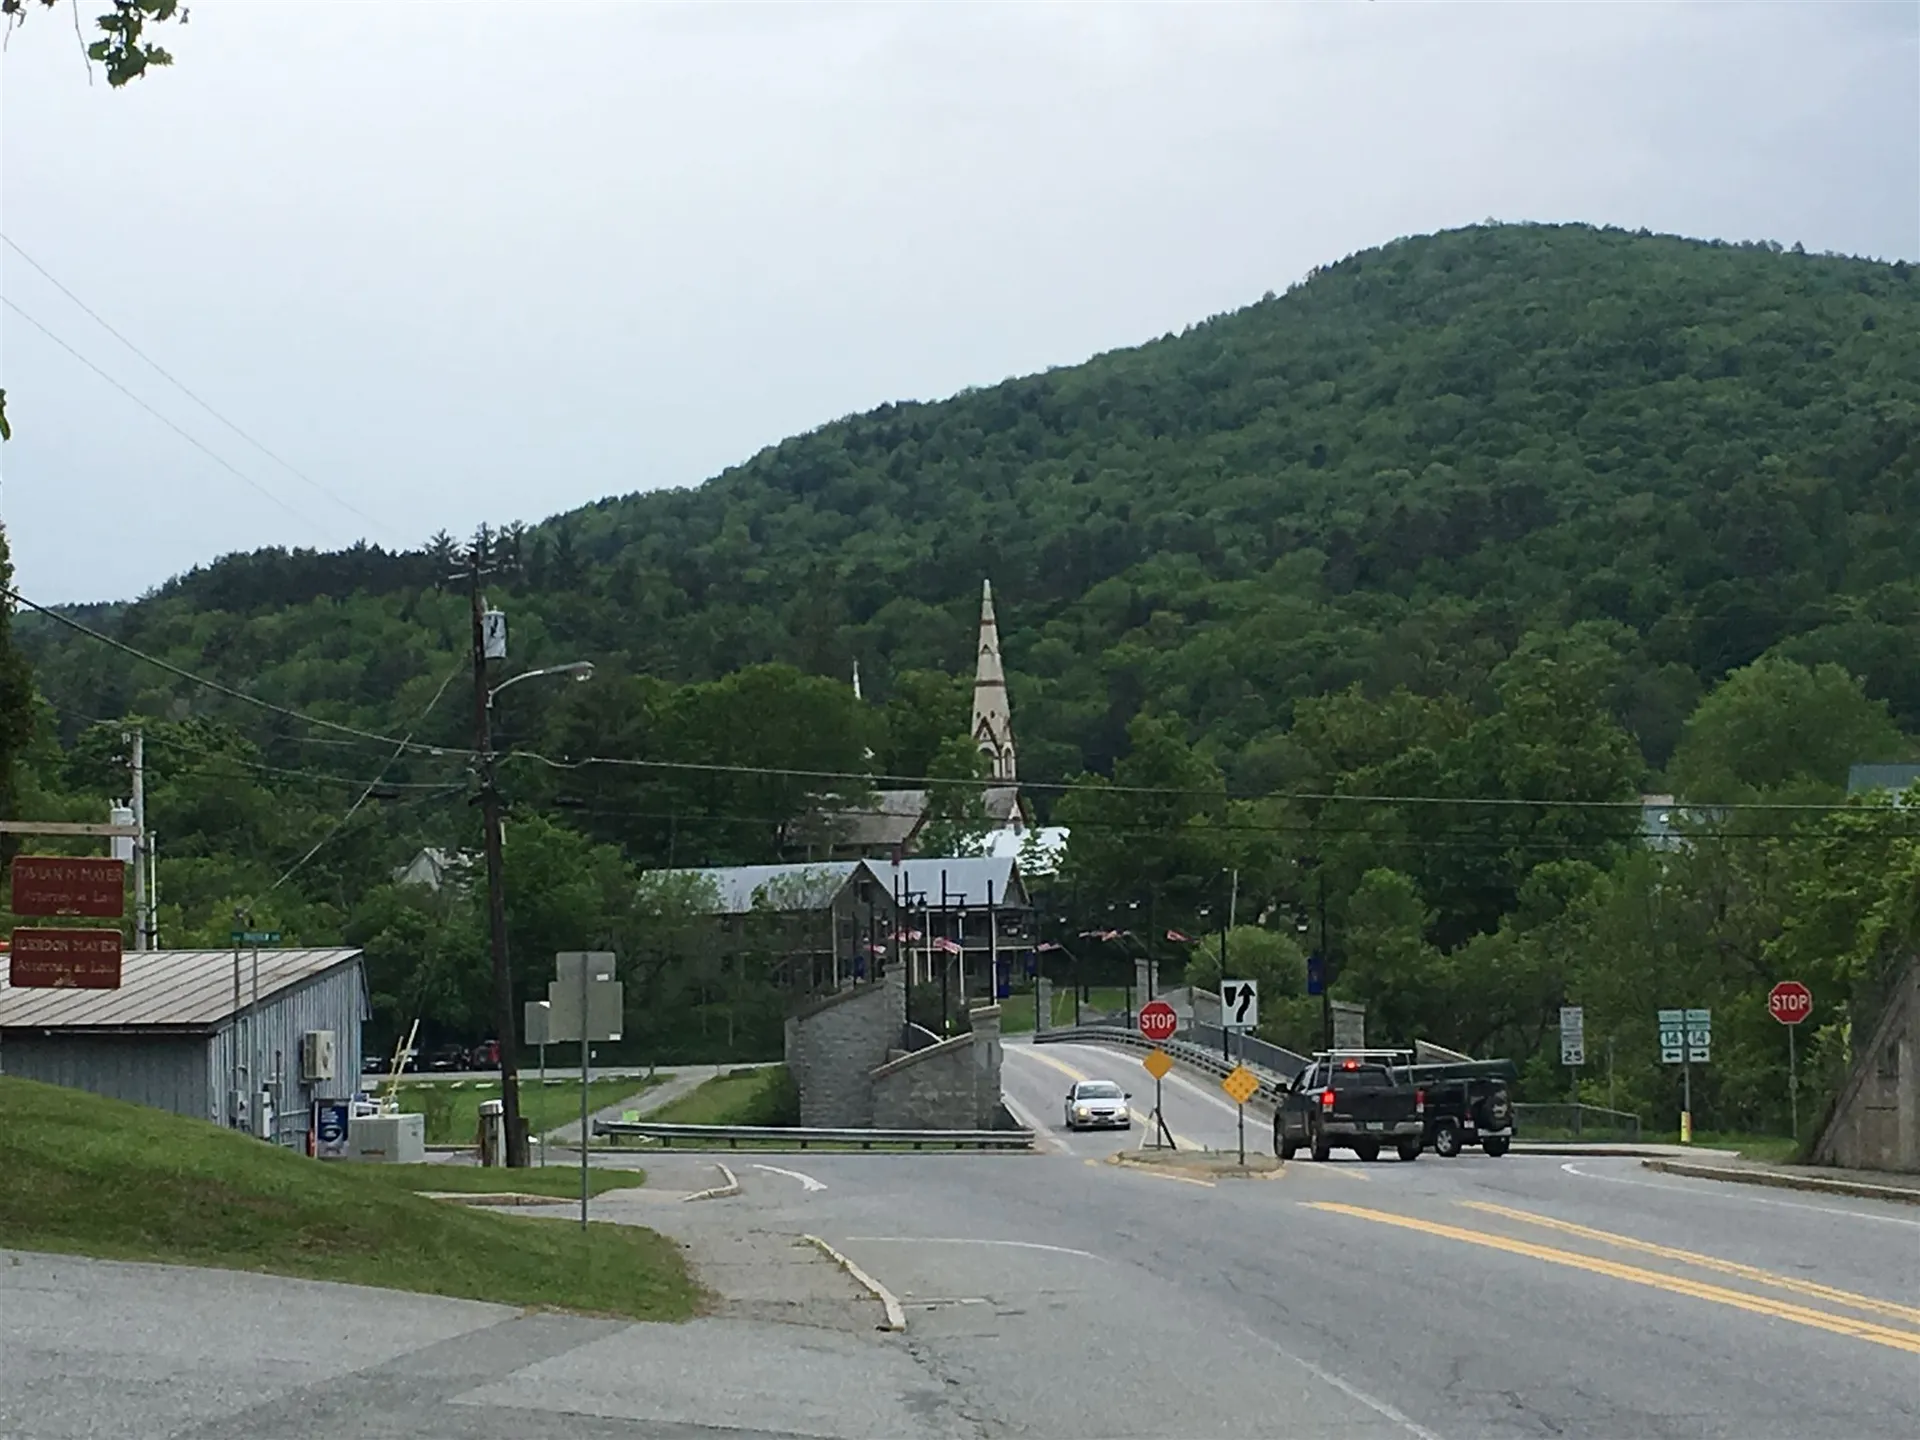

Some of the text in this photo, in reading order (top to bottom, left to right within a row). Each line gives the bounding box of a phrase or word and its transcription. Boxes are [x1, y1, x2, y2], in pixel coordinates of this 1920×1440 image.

[1772, 994, 1808, 1011] STOP
[1141, 1013, 1175, 1029] STOP
[1665, 1031, 1679, 1045] 14
[1692, 1031, 1706, 1044] 14
[1564, 1050, 1583, 1062] 25
